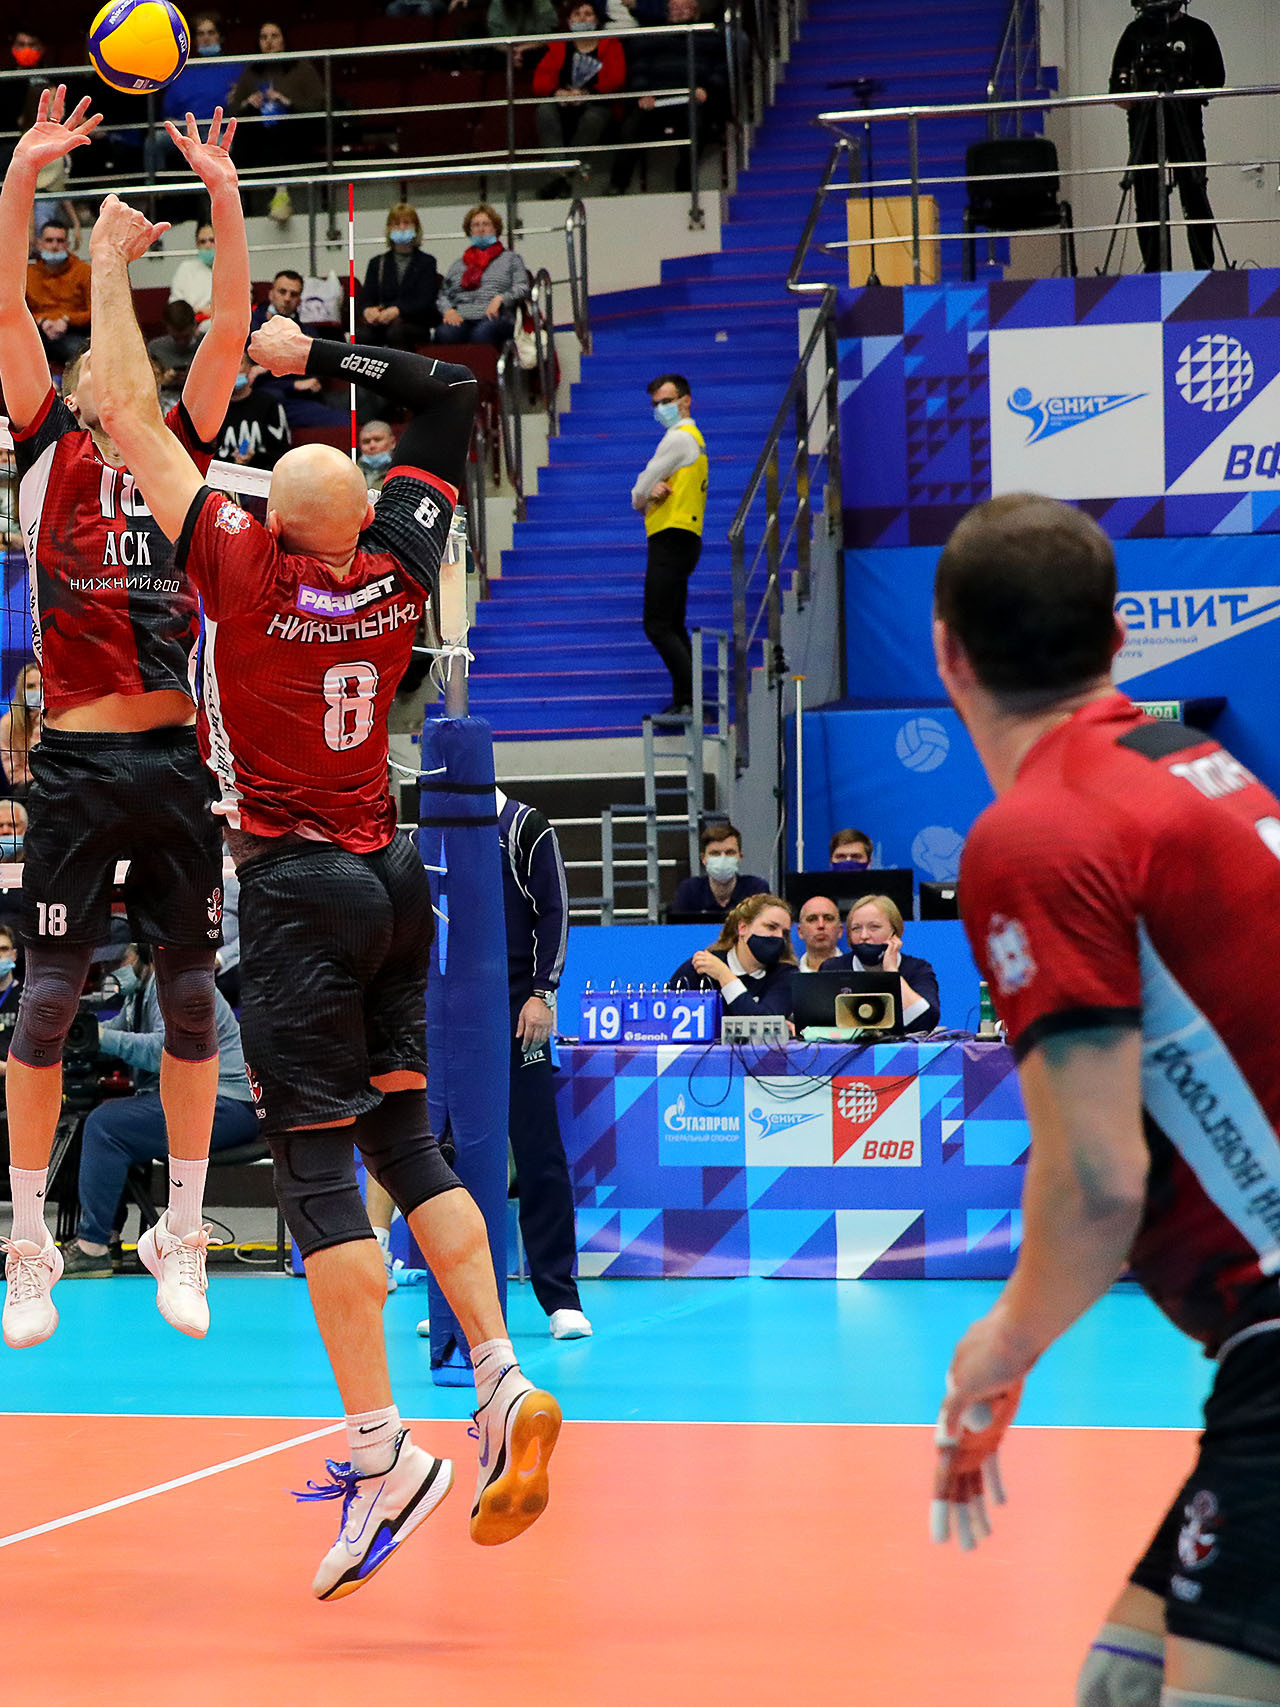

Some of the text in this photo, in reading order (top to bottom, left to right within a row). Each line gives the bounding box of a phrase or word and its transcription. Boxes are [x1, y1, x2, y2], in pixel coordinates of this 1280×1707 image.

[340, 353, 371, 374] cep
[1223, 441, 1280, 481] ВФ
[414, 496, 440, 528] 8
[102, 531, 152, 566] АСК
[300, 575, 395, 612] PARIBET
[323, 661, 379, 752] 8
[36, 901, 68, 937] 18
[583, 1001, 706, 1040] 19 1 0 21
[686, 1116, 740, 1132] ГАЗПРОМ
[862, 1140, 916, 1160] ВФВ
